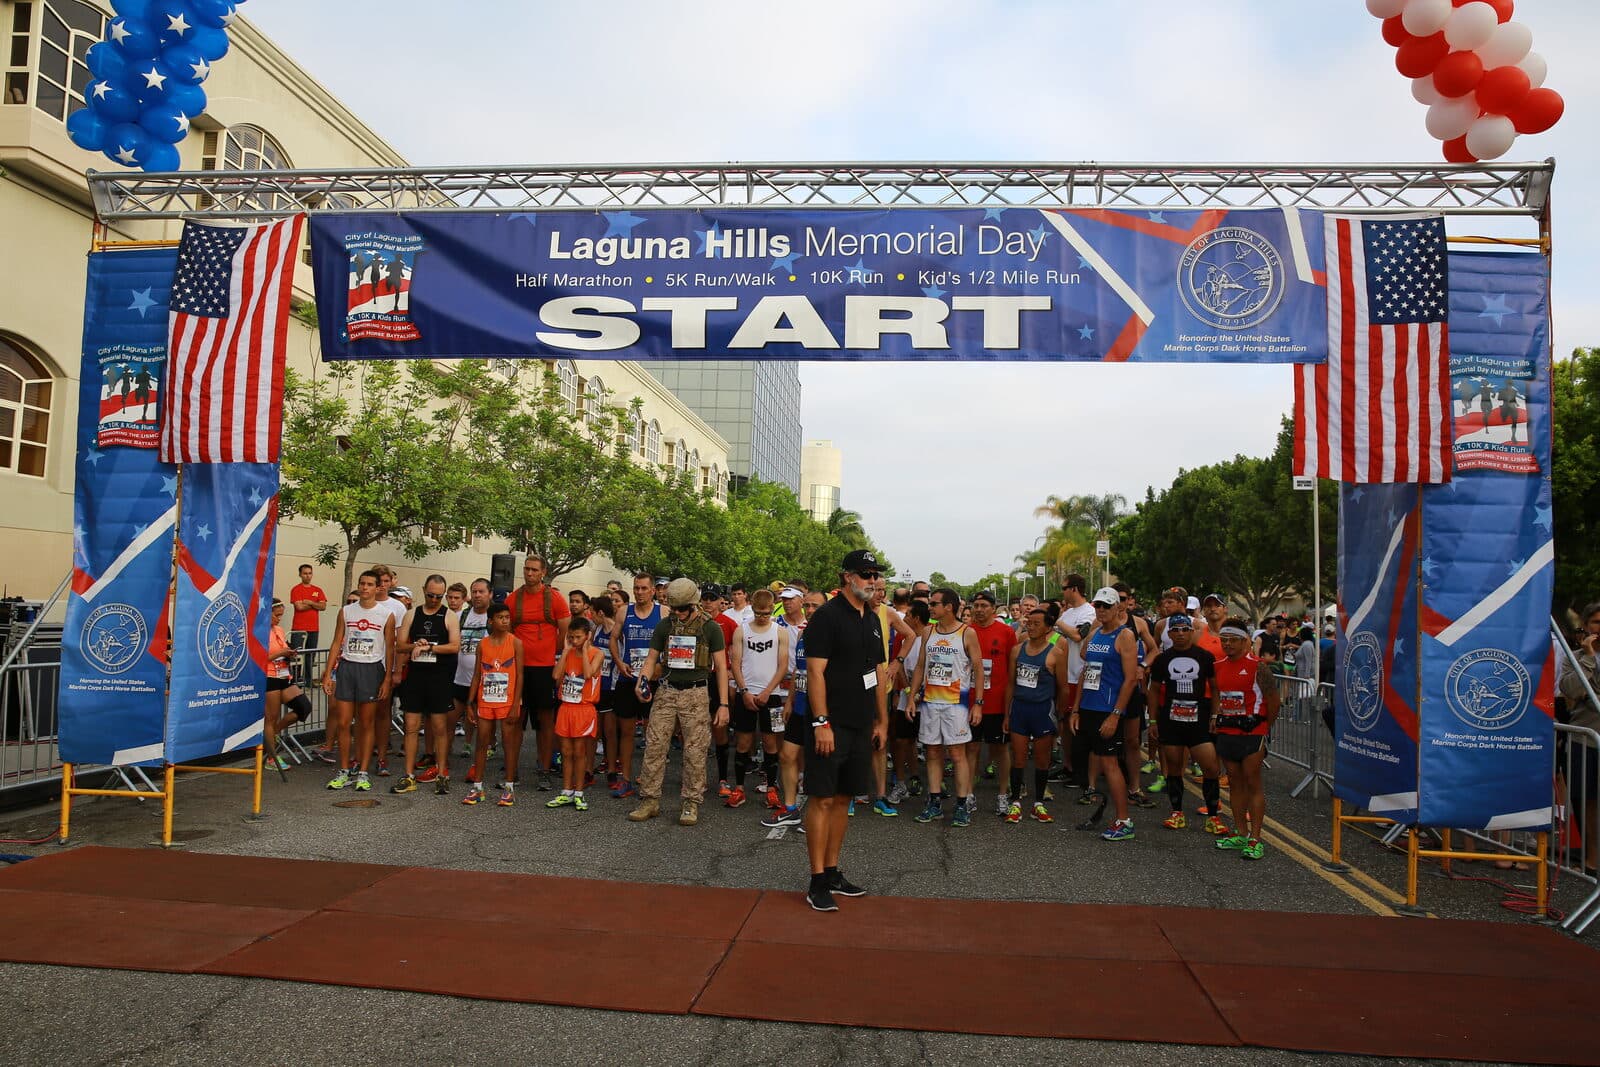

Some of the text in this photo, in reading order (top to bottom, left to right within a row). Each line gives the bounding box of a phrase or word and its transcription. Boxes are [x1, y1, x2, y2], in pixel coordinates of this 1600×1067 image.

[374, 232, 402, 242] Laguna
[345, 241, 372, 250] Memorial
[373, 241, 383, 249] Day
[549, 225, 1046, 265] Laguna Hills Memorial Day
[1183, 230, 1279, 268] CITY OF LAGUNA HILLS
[516, 270, 1080, 287] Half Marathon 5K Run/Walk 10K Run Kid's 1/2 Mile Run
[535, 295, 1051, 351] START
[1179, 333, 1290, 343] Honoring the United States
[97, 344, 165, 356] City of Laguna Hills
[1164, 343, 1307, 353] Marine Corps Dark Horse Battalion
[98, 354, 121, 364] Memorial
[121, 353, 131, 361] Day
[1464, 355, 1473, 363] of
[1476, 356, 1510, 367] Laguna
[1512, 359, 1530, 368] Hills
[1477, 366, 1489, 374] Day
[1491, 444, 1508, 452] Kids
[748, 639, 773, 653] USA
[927, 645, 959, 654] SunRype
[1463, 654, 1473, 663] OF
[1476, 651, 1510, 662] LAGUNA
[1512, 660, 1528, 682] HILLS
[1444, 732, 1477, 742] Honoring
[1432, 739, 1456, 747] Marine
[1457, 740, 1478, 748] Corps
